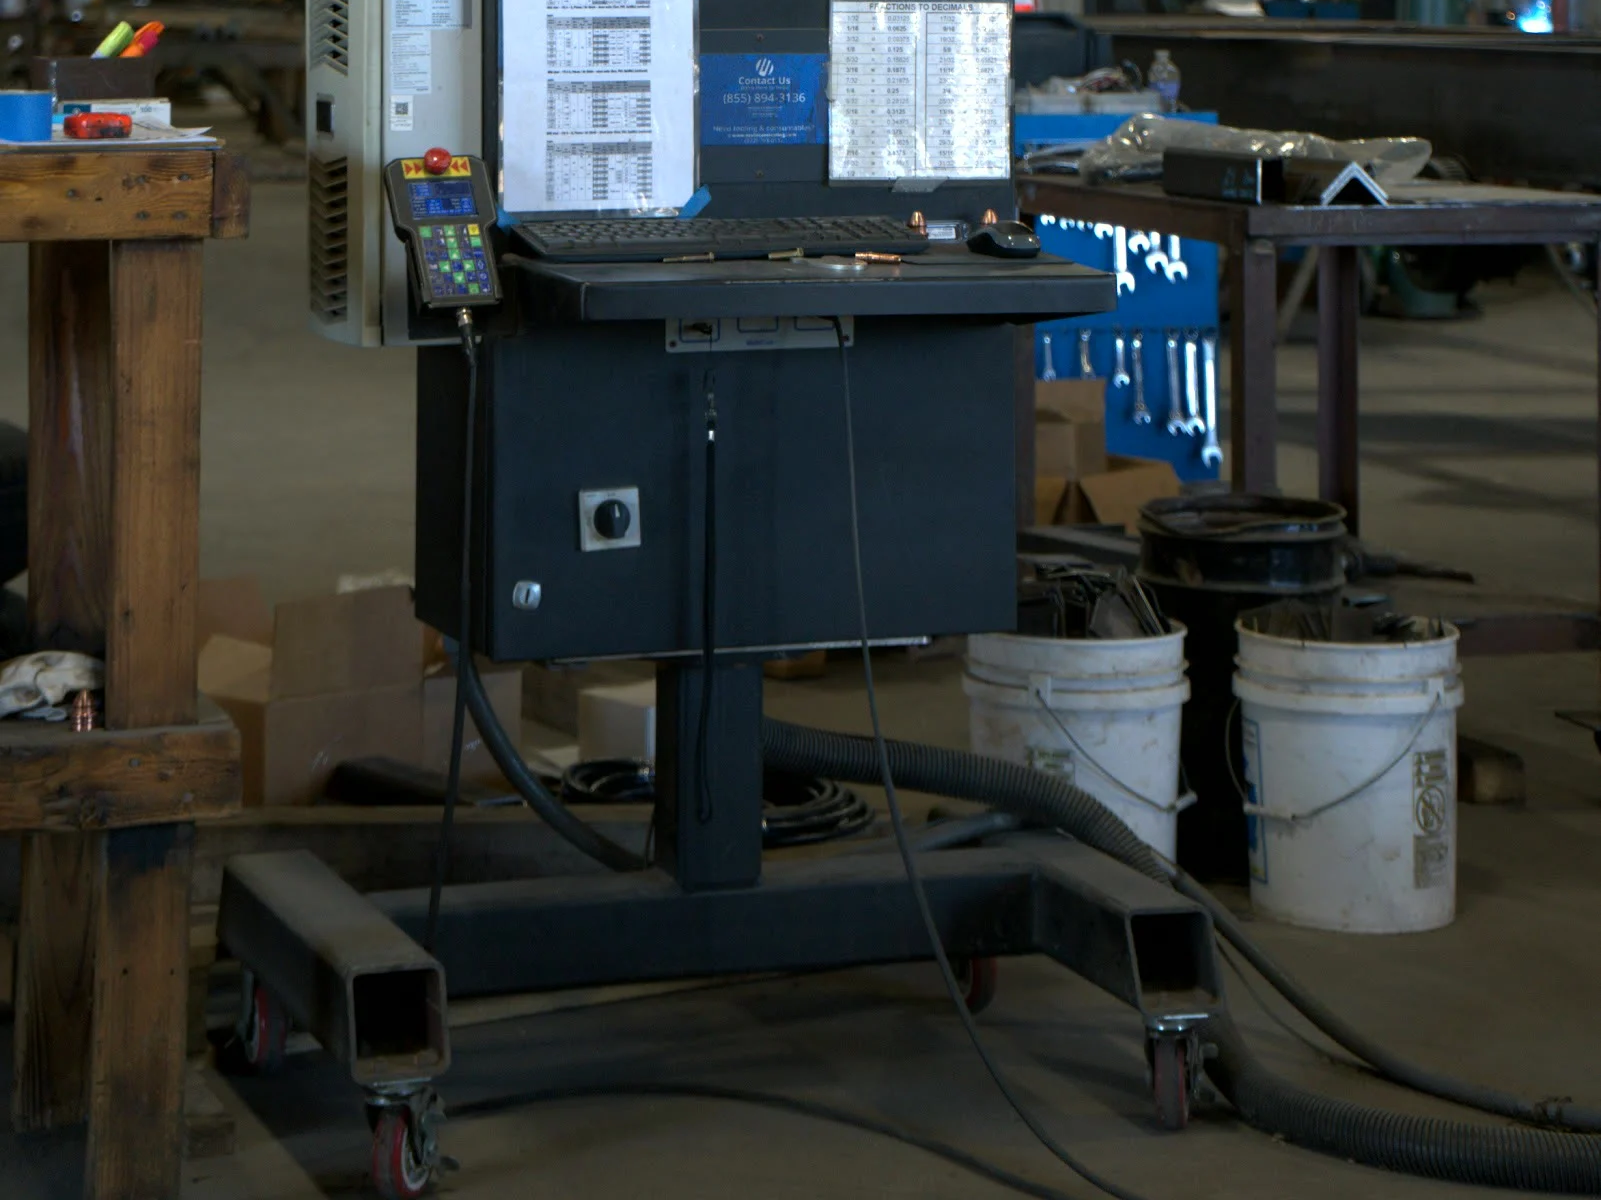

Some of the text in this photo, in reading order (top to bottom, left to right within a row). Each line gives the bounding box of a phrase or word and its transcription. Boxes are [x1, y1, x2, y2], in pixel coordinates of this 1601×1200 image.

[738, 76, 791, 84] Contact Us
[722, 92, 806, 104] (855) 894-3136
